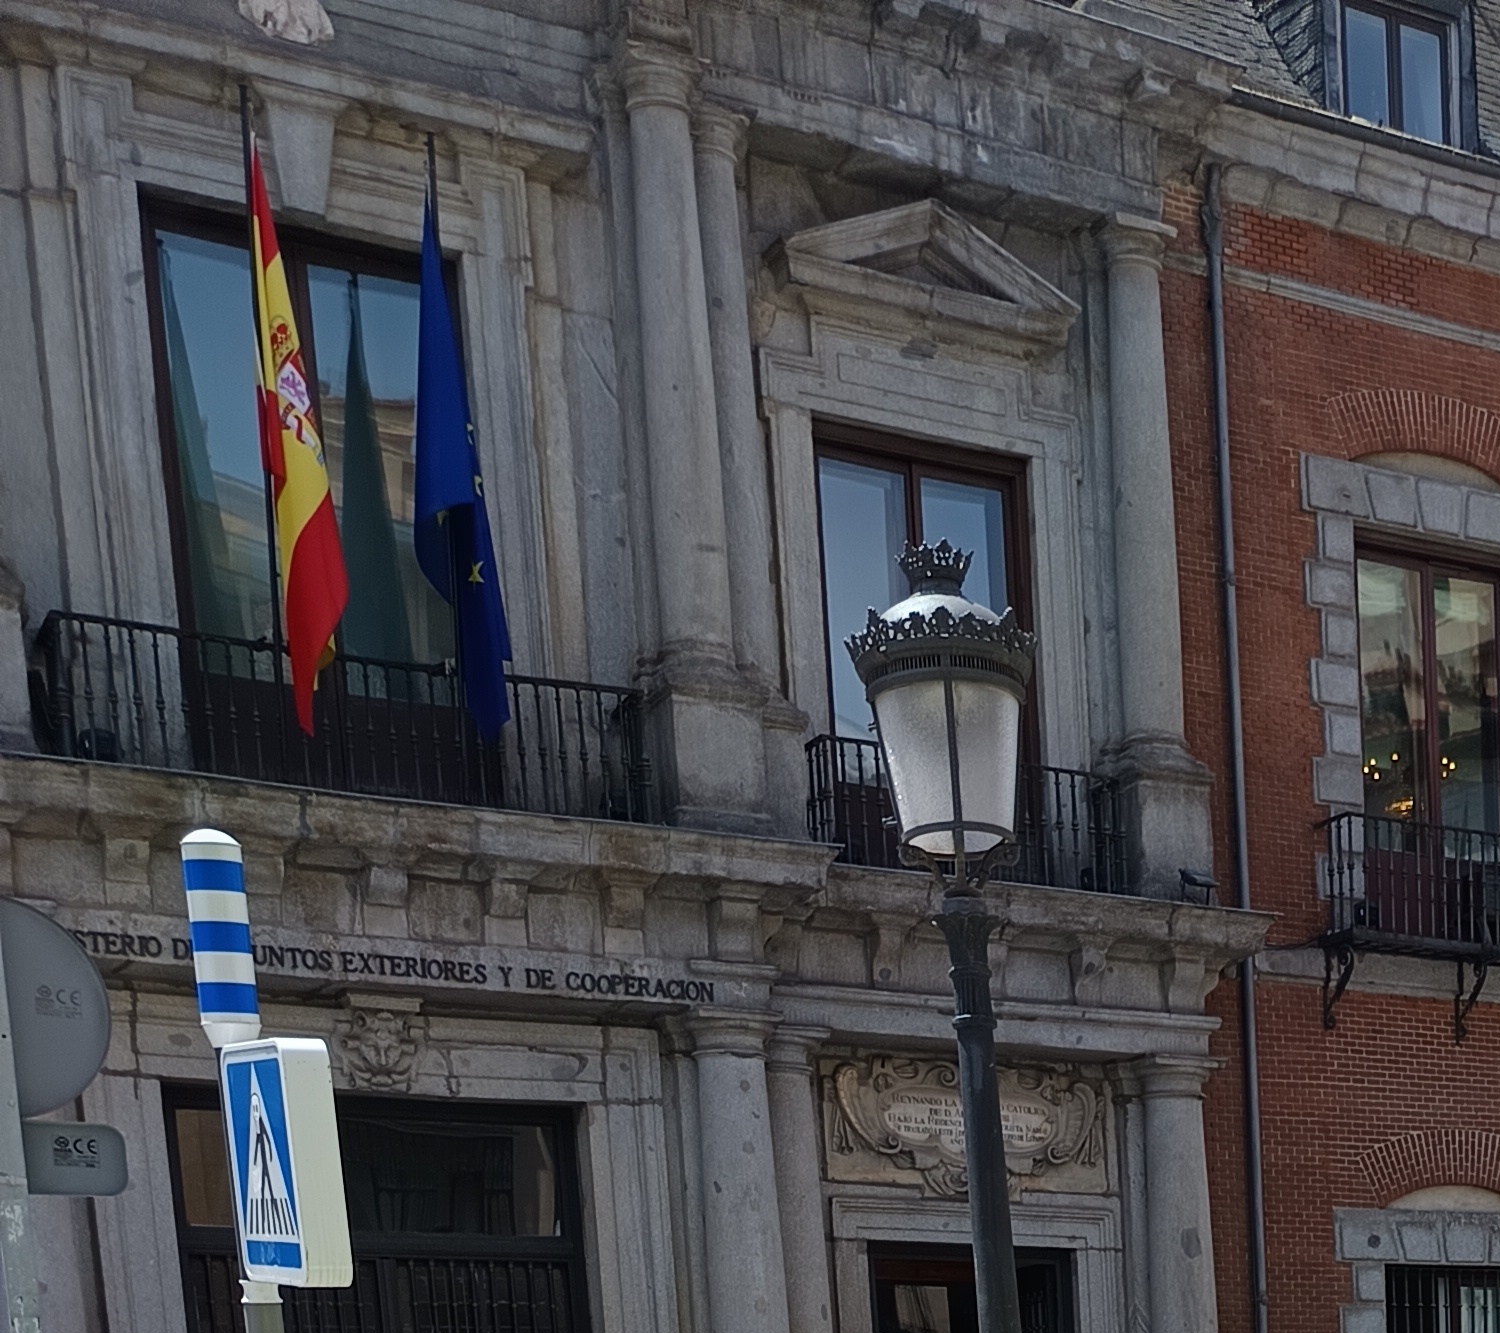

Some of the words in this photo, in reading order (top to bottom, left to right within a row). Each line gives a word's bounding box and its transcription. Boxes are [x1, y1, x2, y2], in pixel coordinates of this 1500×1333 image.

[252, 944, 333, 971] UNTOS
[340, 950, 488, 985] EXTERIORES
[497, 965, 513, 988] Y
[525, 967, 557, 991] DE
[565, 971, 715, 1003] COOPERACION
